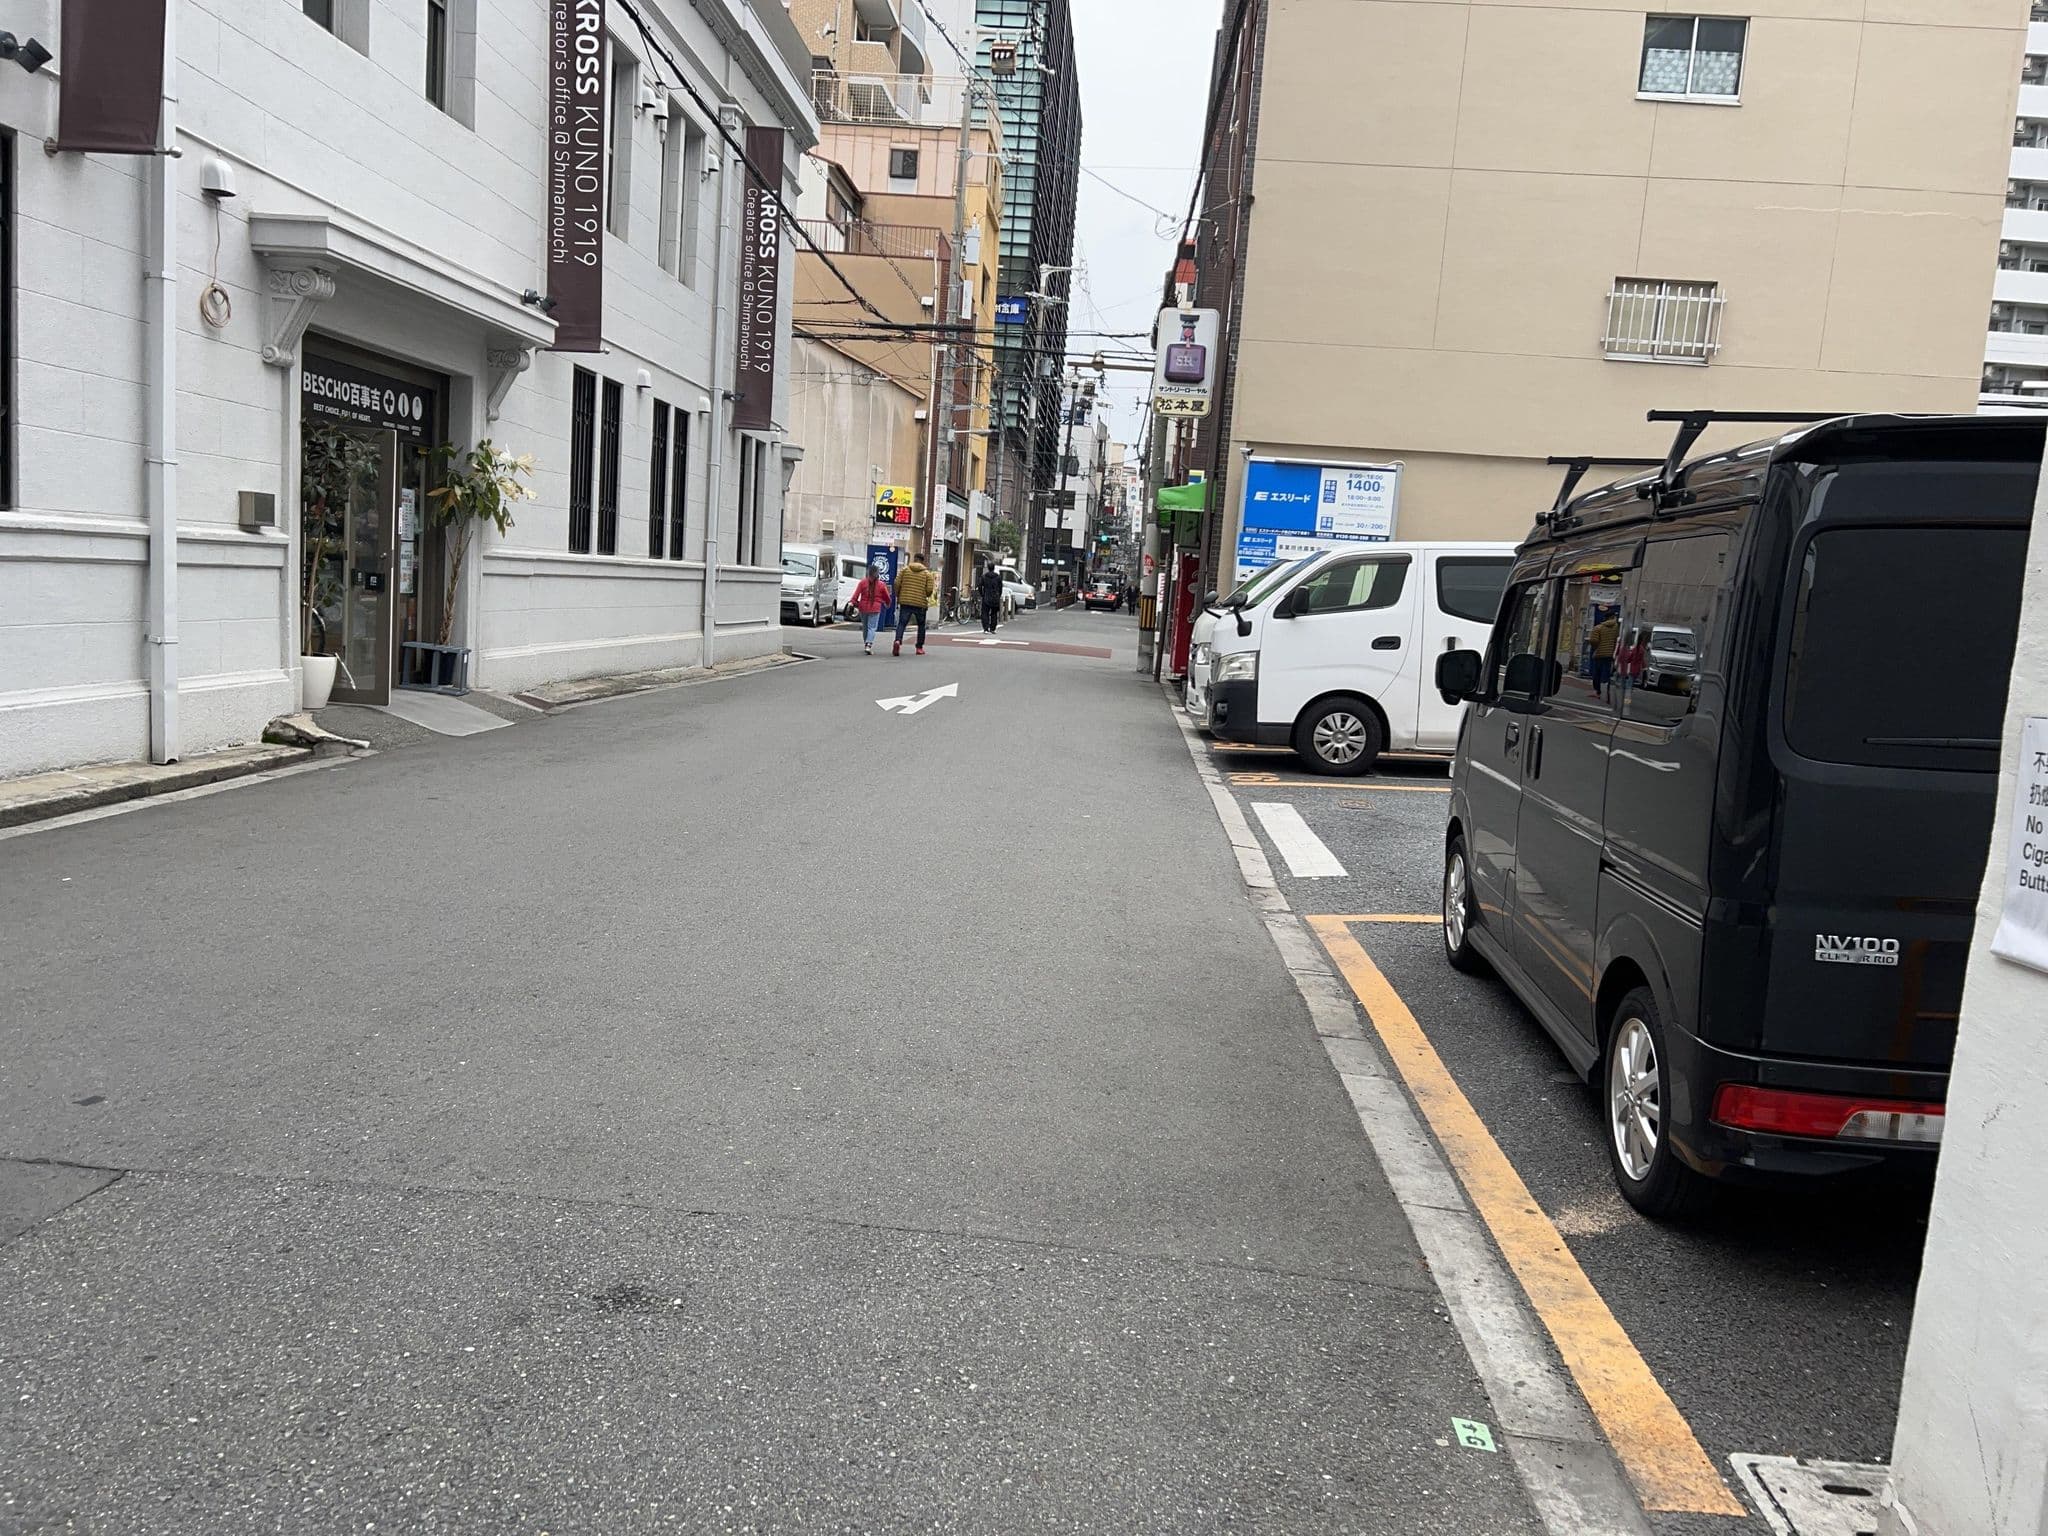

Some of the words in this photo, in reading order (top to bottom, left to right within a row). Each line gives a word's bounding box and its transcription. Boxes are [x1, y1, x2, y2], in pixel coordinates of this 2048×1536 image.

[555, 0, 571, 70] reator's
[554, 76, 571, 125] office
[575, 106, 599, 193] KUNO
[552, 150, 570, 264] Shimanouchi
[745, 188, 759, 242] Creator's
[759, 189, 778, 258] KROSS
[574, 204, 598, 266] 1919
[743, 245, 756, 278] office
[756, 265, 775, 323] KUNO
[740, 294, 754, 370] Shimanouchi
[754, 330, 772, 373] 1919
[1159, 385, 1208, 394] サントリーローヤル
[1160, 398, 1205, 412] 松本屋
[1270, 492, 1311, 503] エスリード
[2026, 814, 2043, 835] No
[1815, 934, 1900, 953] NV100
[1873, 955, 1895, 964] RIO
